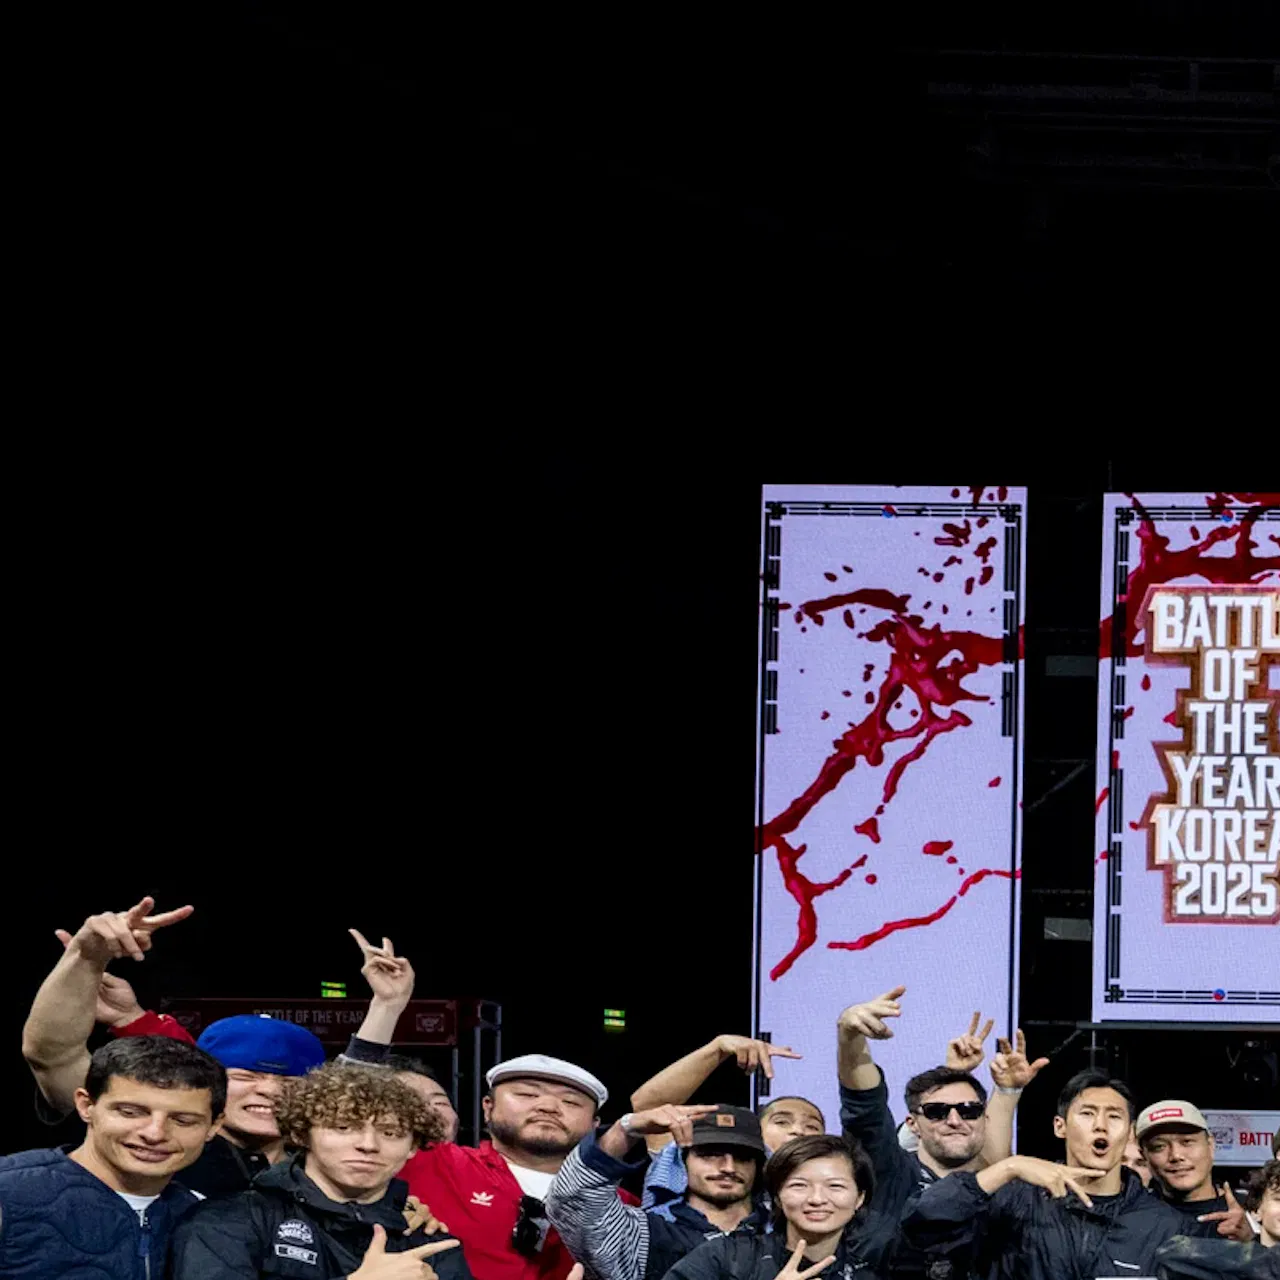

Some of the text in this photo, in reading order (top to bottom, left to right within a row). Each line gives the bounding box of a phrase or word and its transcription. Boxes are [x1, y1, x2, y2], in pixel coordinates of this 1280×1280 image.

[1205, 649, 1258, 702] OF
[1189, 702, 1270, 754] THE
[1175, 865, 1277, 916] 2025
